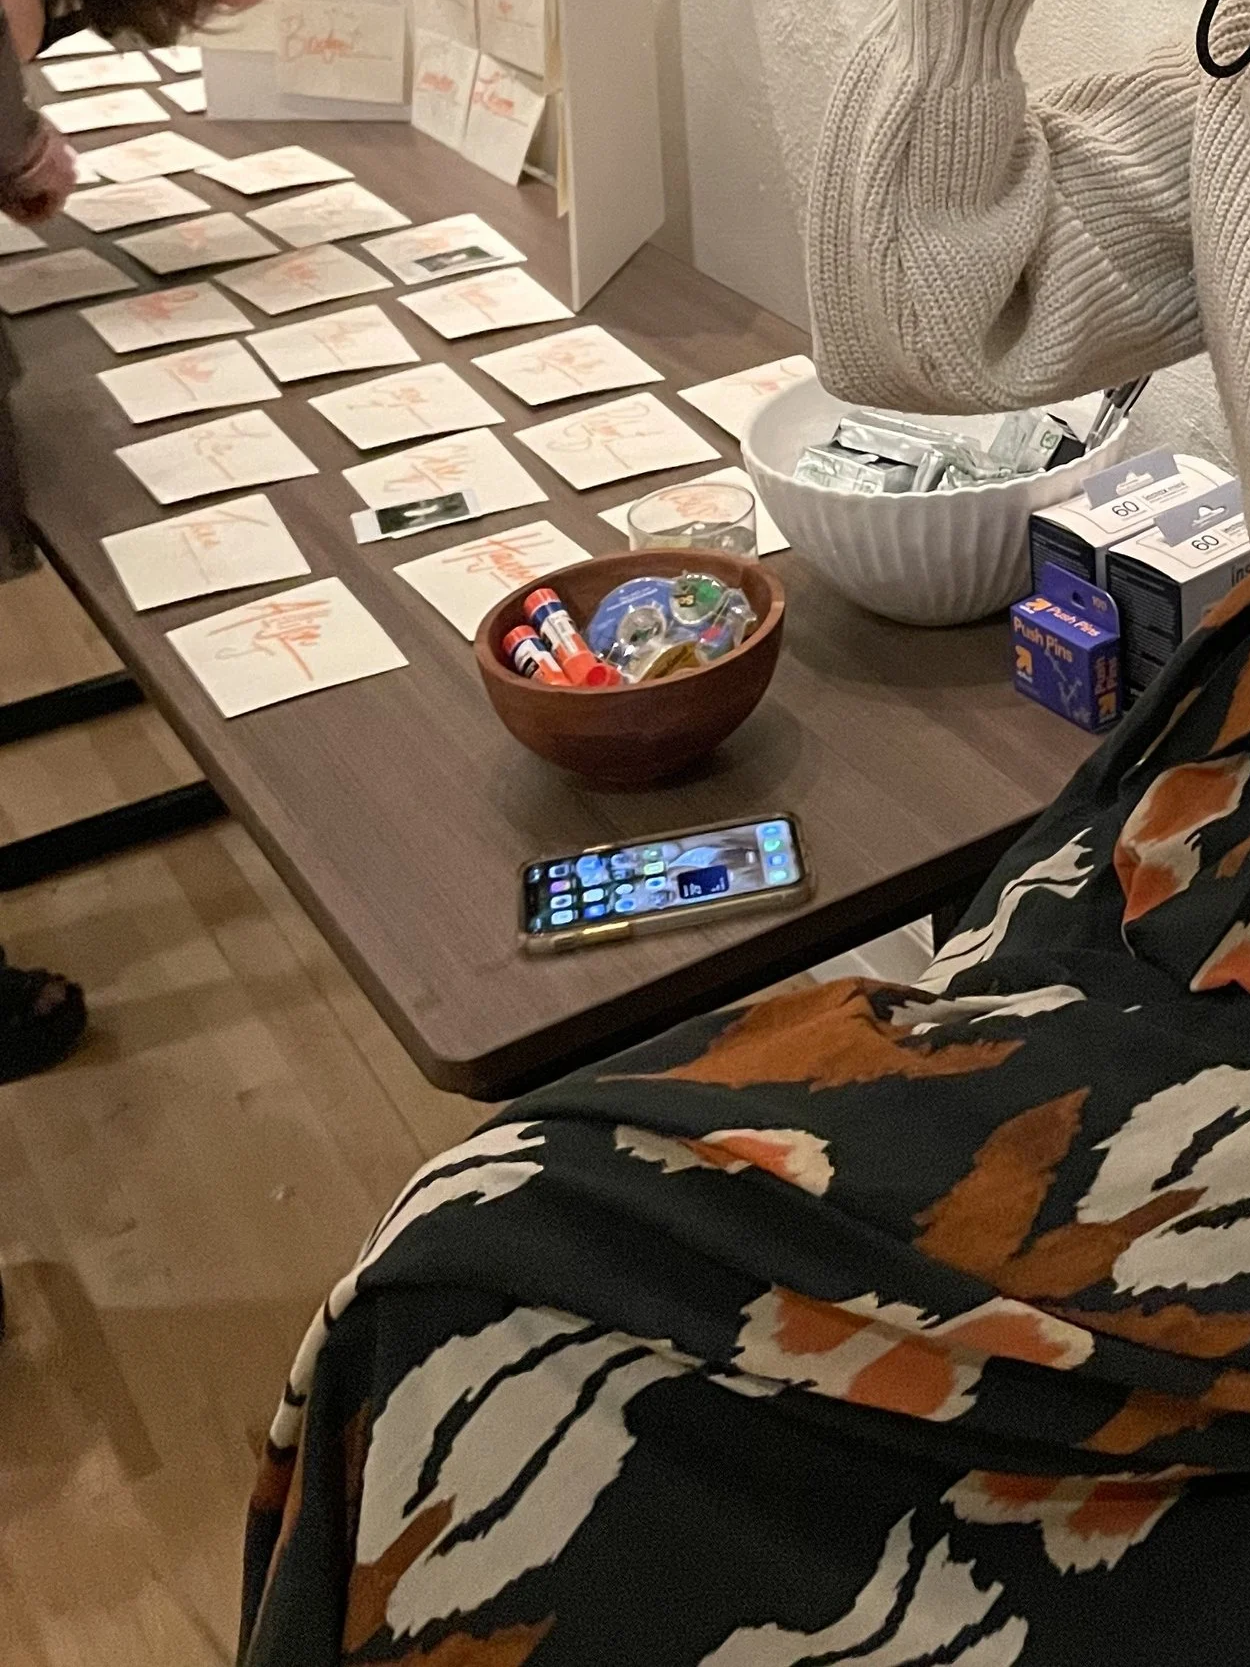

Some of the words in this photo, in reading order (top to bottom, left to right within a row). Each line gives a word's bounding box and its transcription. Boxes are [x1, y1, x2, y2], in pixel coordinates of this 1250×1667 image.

[1111, 500, 1140, 517] 60
[1191, 534, 1219, 551] 60
[1046, 606, 1076, 625] Push
[1074, 619, 1101, 638] Pins
[1013, 616, 1044, 647] Push
[1045, 635, 1073, 663] Pins
